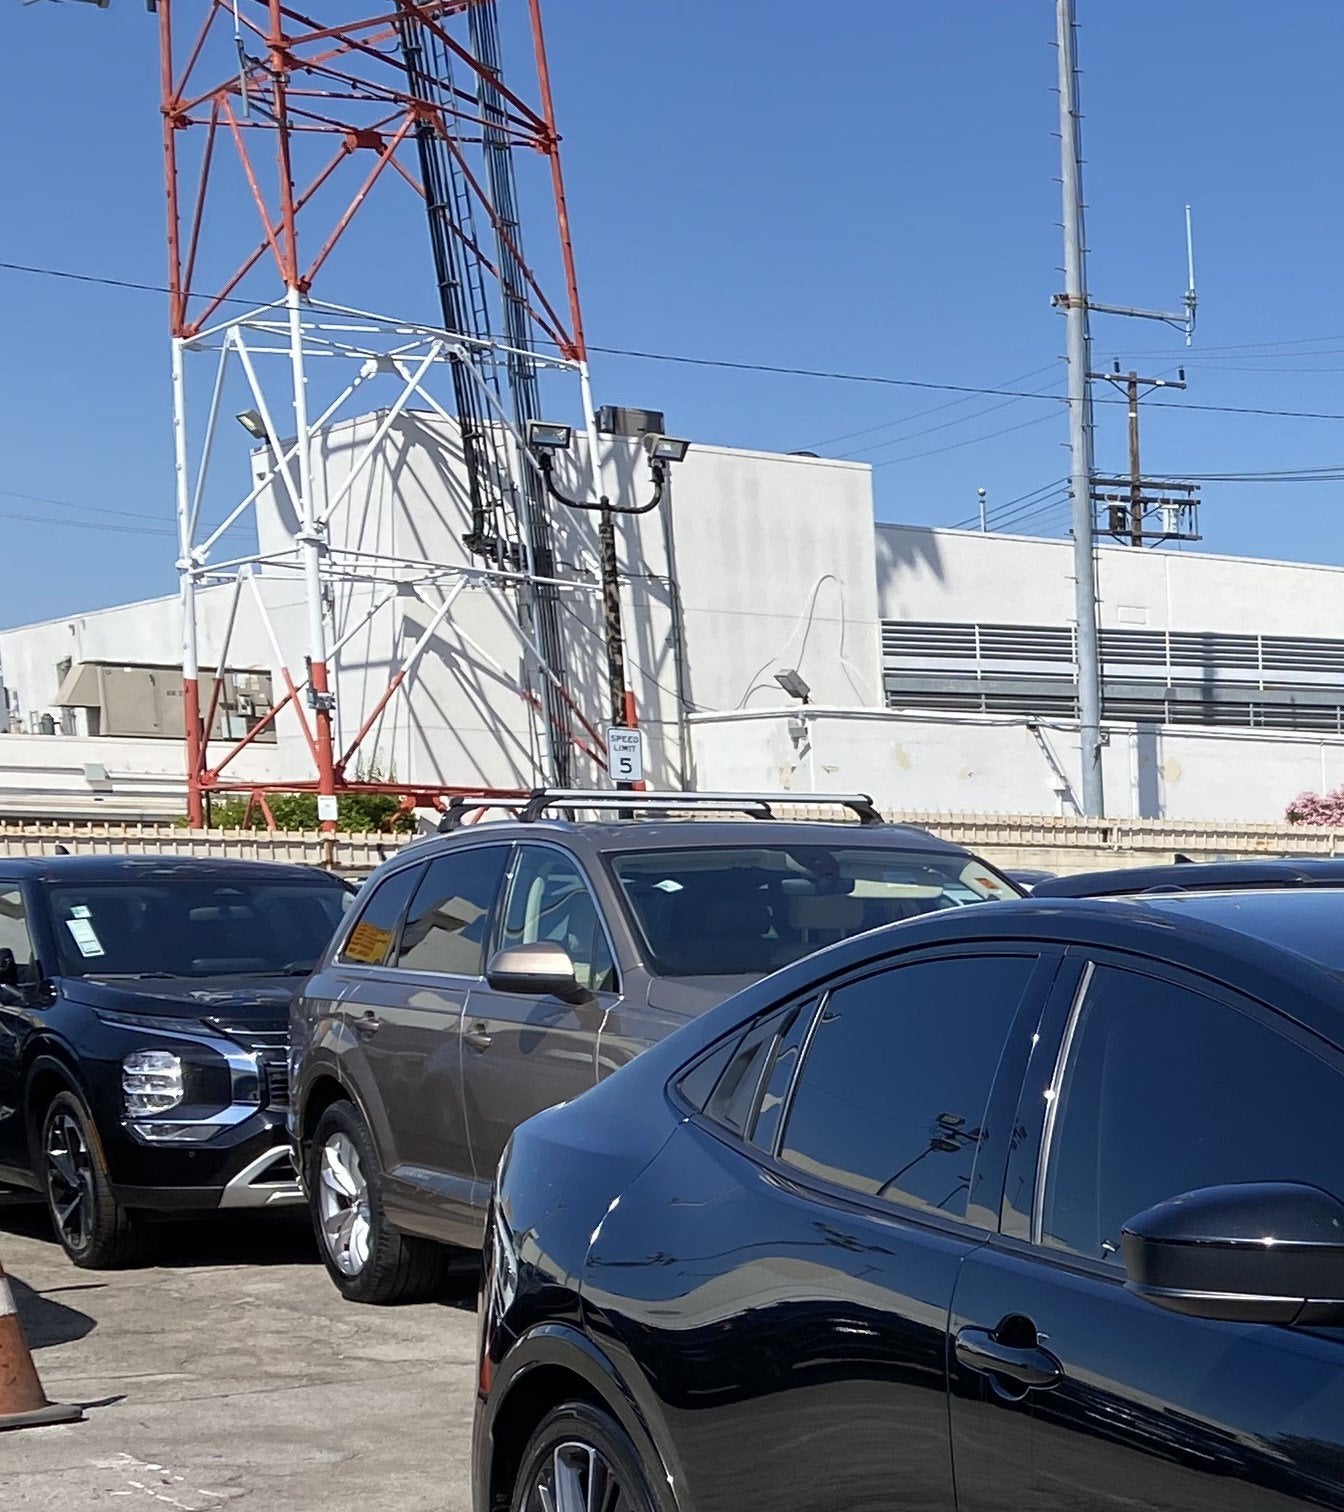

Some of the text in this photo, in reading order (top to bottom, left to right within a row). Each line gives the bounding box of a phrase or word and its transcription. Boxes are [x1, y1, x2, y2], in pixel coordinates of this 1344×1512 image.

[610, 734, 639, 744] SPEED
[613, 744, 637, 753] LIMIT
[620, 757, 632, 774] 5
